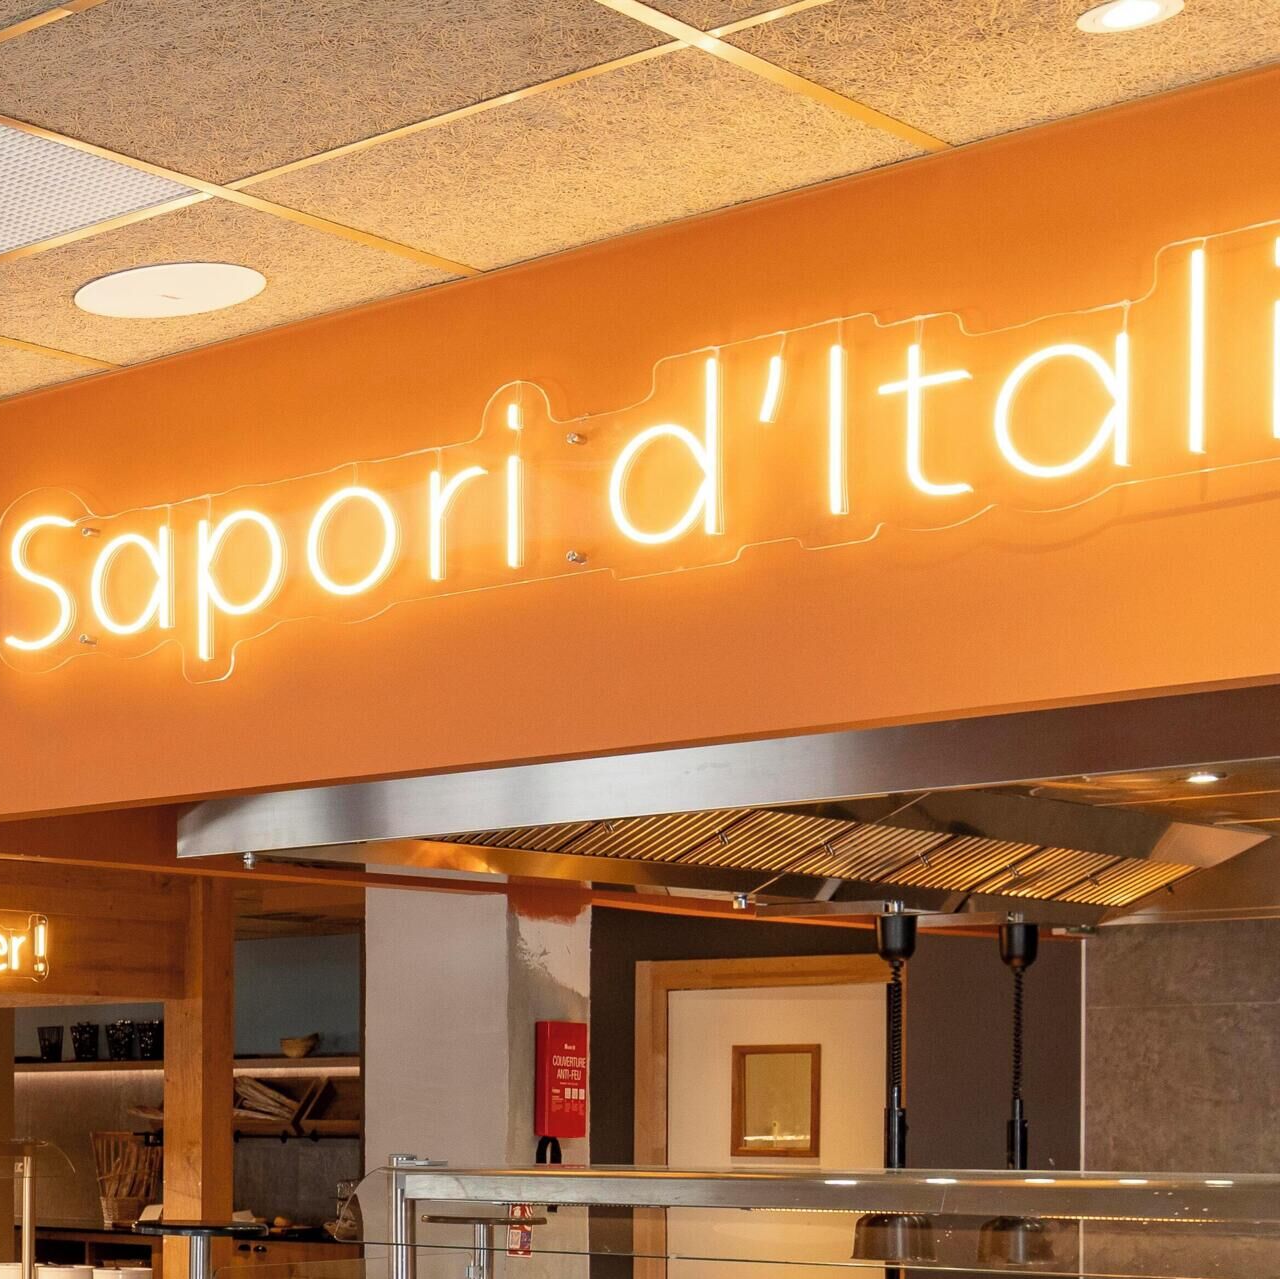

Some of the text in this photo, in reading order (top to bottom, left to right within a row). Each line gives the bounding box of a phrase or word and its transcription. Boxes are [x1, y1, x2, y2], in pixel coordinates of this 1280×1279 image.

[3, 403, 521, 662] Sapori
[552, 1055, 586, 1068] COUVERTURE
[557, 1068, 582, 1080] ANTI-FEU
